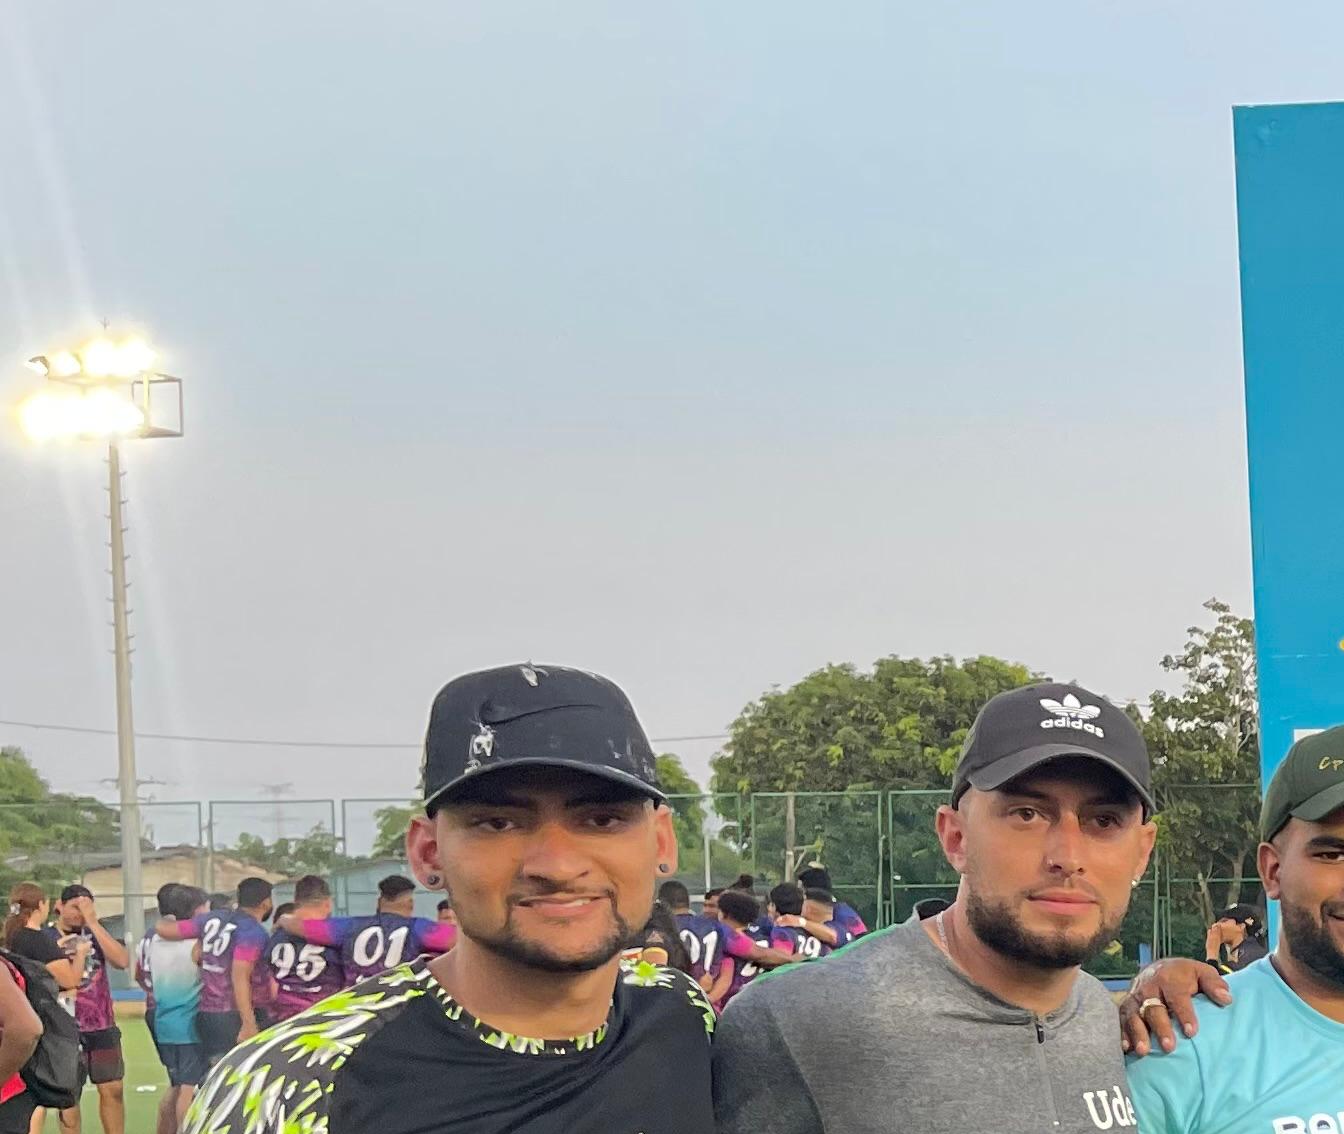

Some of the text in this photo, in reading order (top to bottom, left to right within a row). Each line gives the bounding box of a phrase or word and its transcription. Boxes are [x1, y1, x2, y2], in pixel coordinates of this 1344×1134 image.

[1040, 716, 1104, 738] adidas
[271, 943, 327, 981] 95
[353, 926, 410, 968] 01
